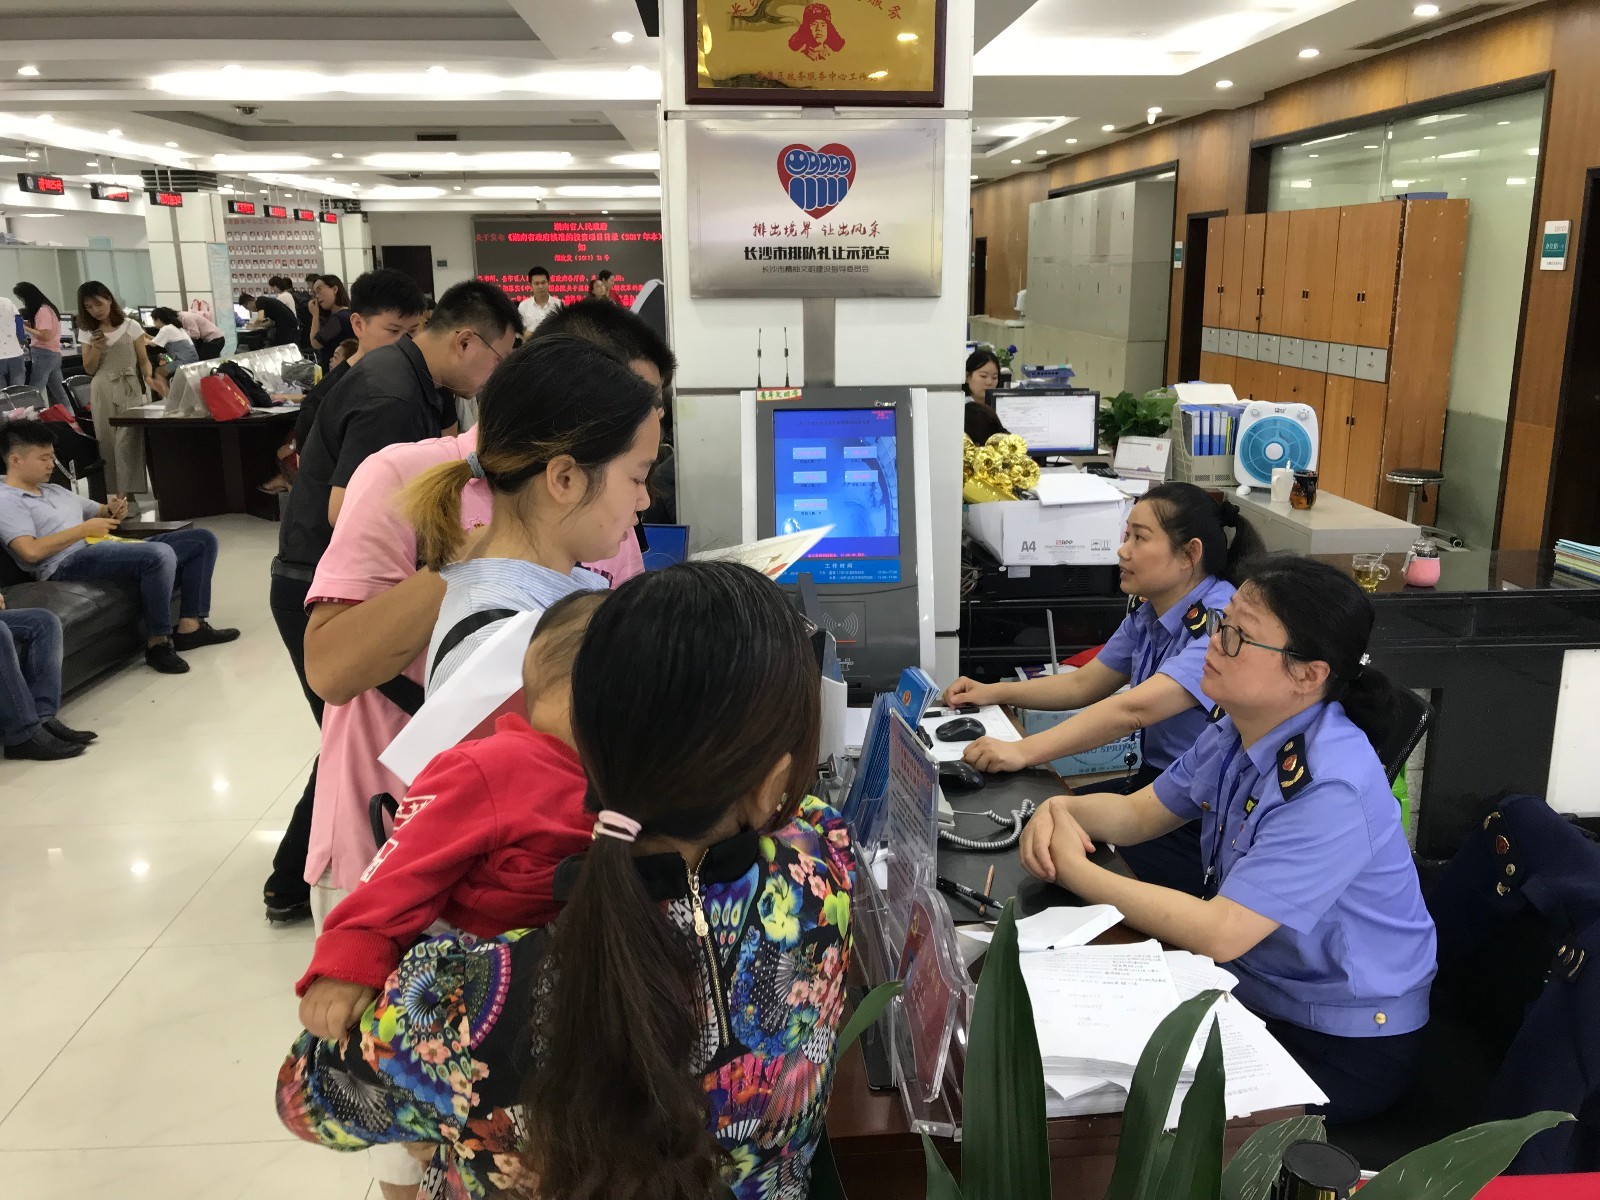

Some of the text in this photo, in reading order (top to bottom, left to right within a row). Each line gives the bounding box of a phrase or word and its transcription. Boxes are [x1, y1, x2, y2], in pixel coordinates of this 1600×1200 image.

[752, 220, 880, 239] 排出境界 让出风采
[743, 246, 890, 260] 长沙市排队礼让示范点
[762, 265, 870, 273] 长沙市精神文明建设指导委员会
[1021, 541, 1036, 552] A4
